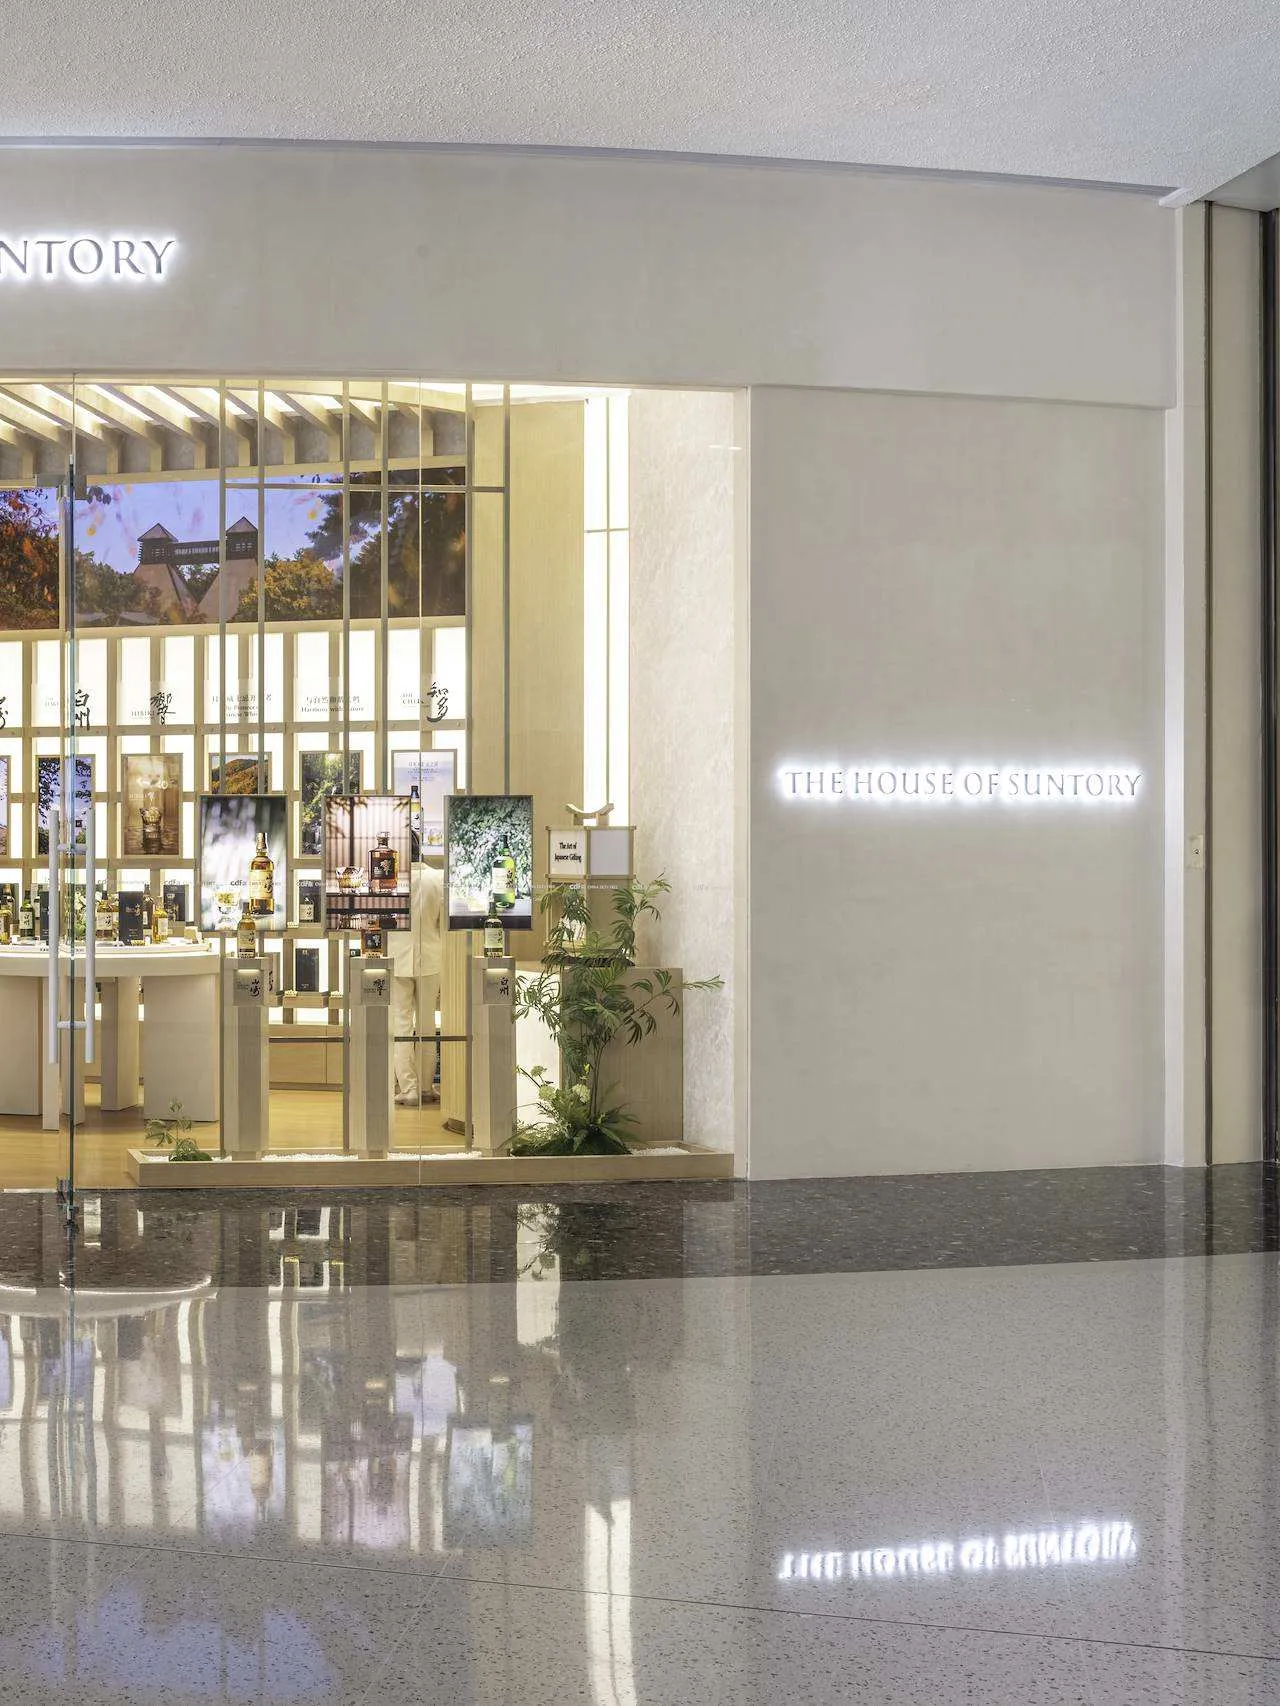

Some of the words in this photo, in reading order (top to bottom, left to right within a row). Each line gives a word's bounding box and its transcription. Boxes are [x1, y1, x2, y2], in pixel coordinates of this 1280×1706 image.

[785, 772, 844, 794] THE
[854, 772, 954, 796] HOUSE
[964, 772, 1000, 796] OF
[1008, 773, 1144, 796] SUNTORY
